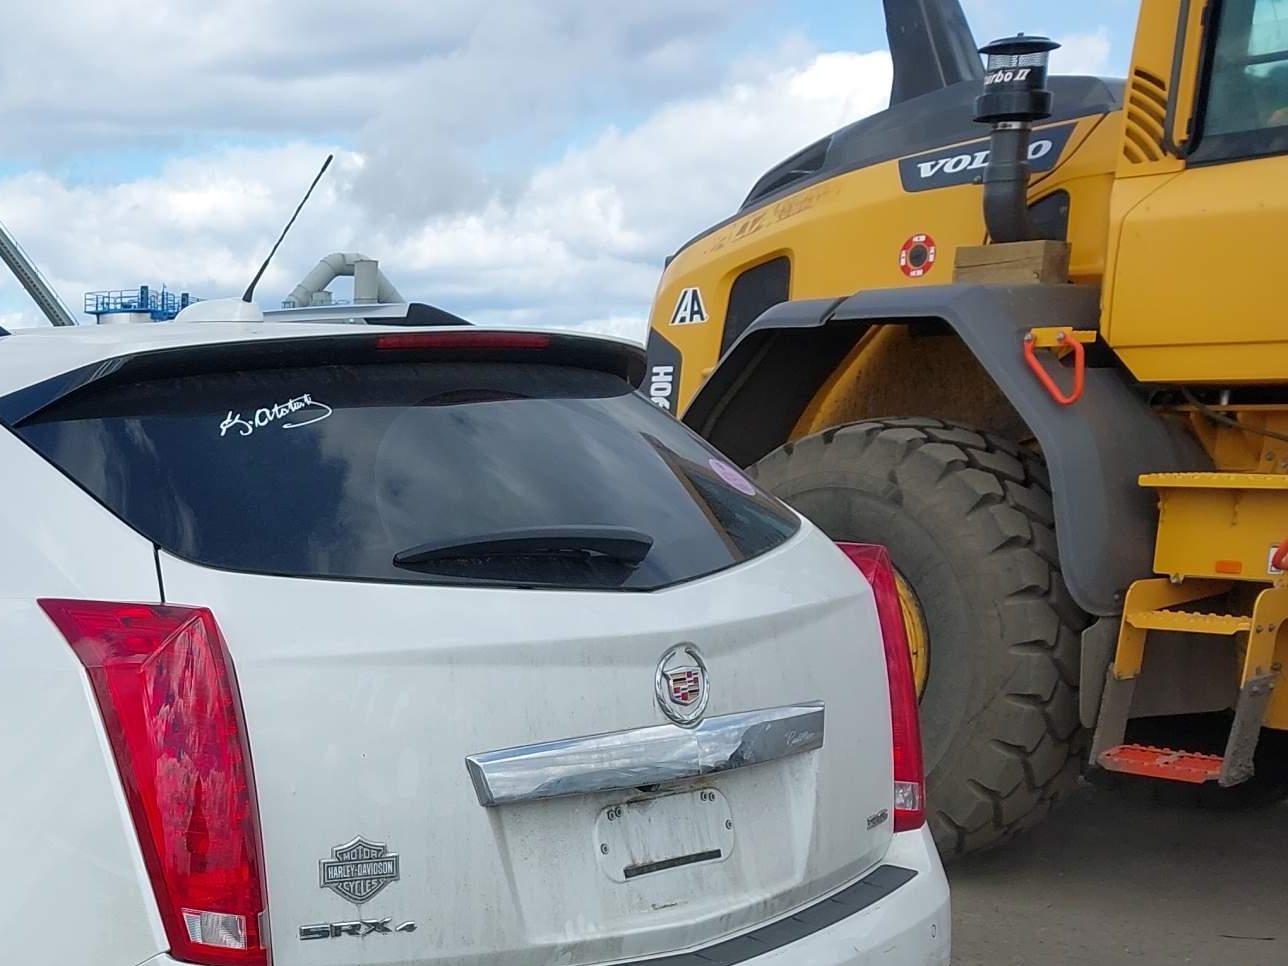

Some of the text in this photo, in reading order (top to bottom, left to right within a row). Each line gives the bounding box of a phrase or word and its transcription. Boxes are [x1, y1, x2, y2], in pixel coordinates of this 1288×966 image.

[917, 140, 1053, 178] VOLO
[327, 861, 393, 879] HARLEY-DAVIDSON
[342, 879, 380, 897] CYCLES
